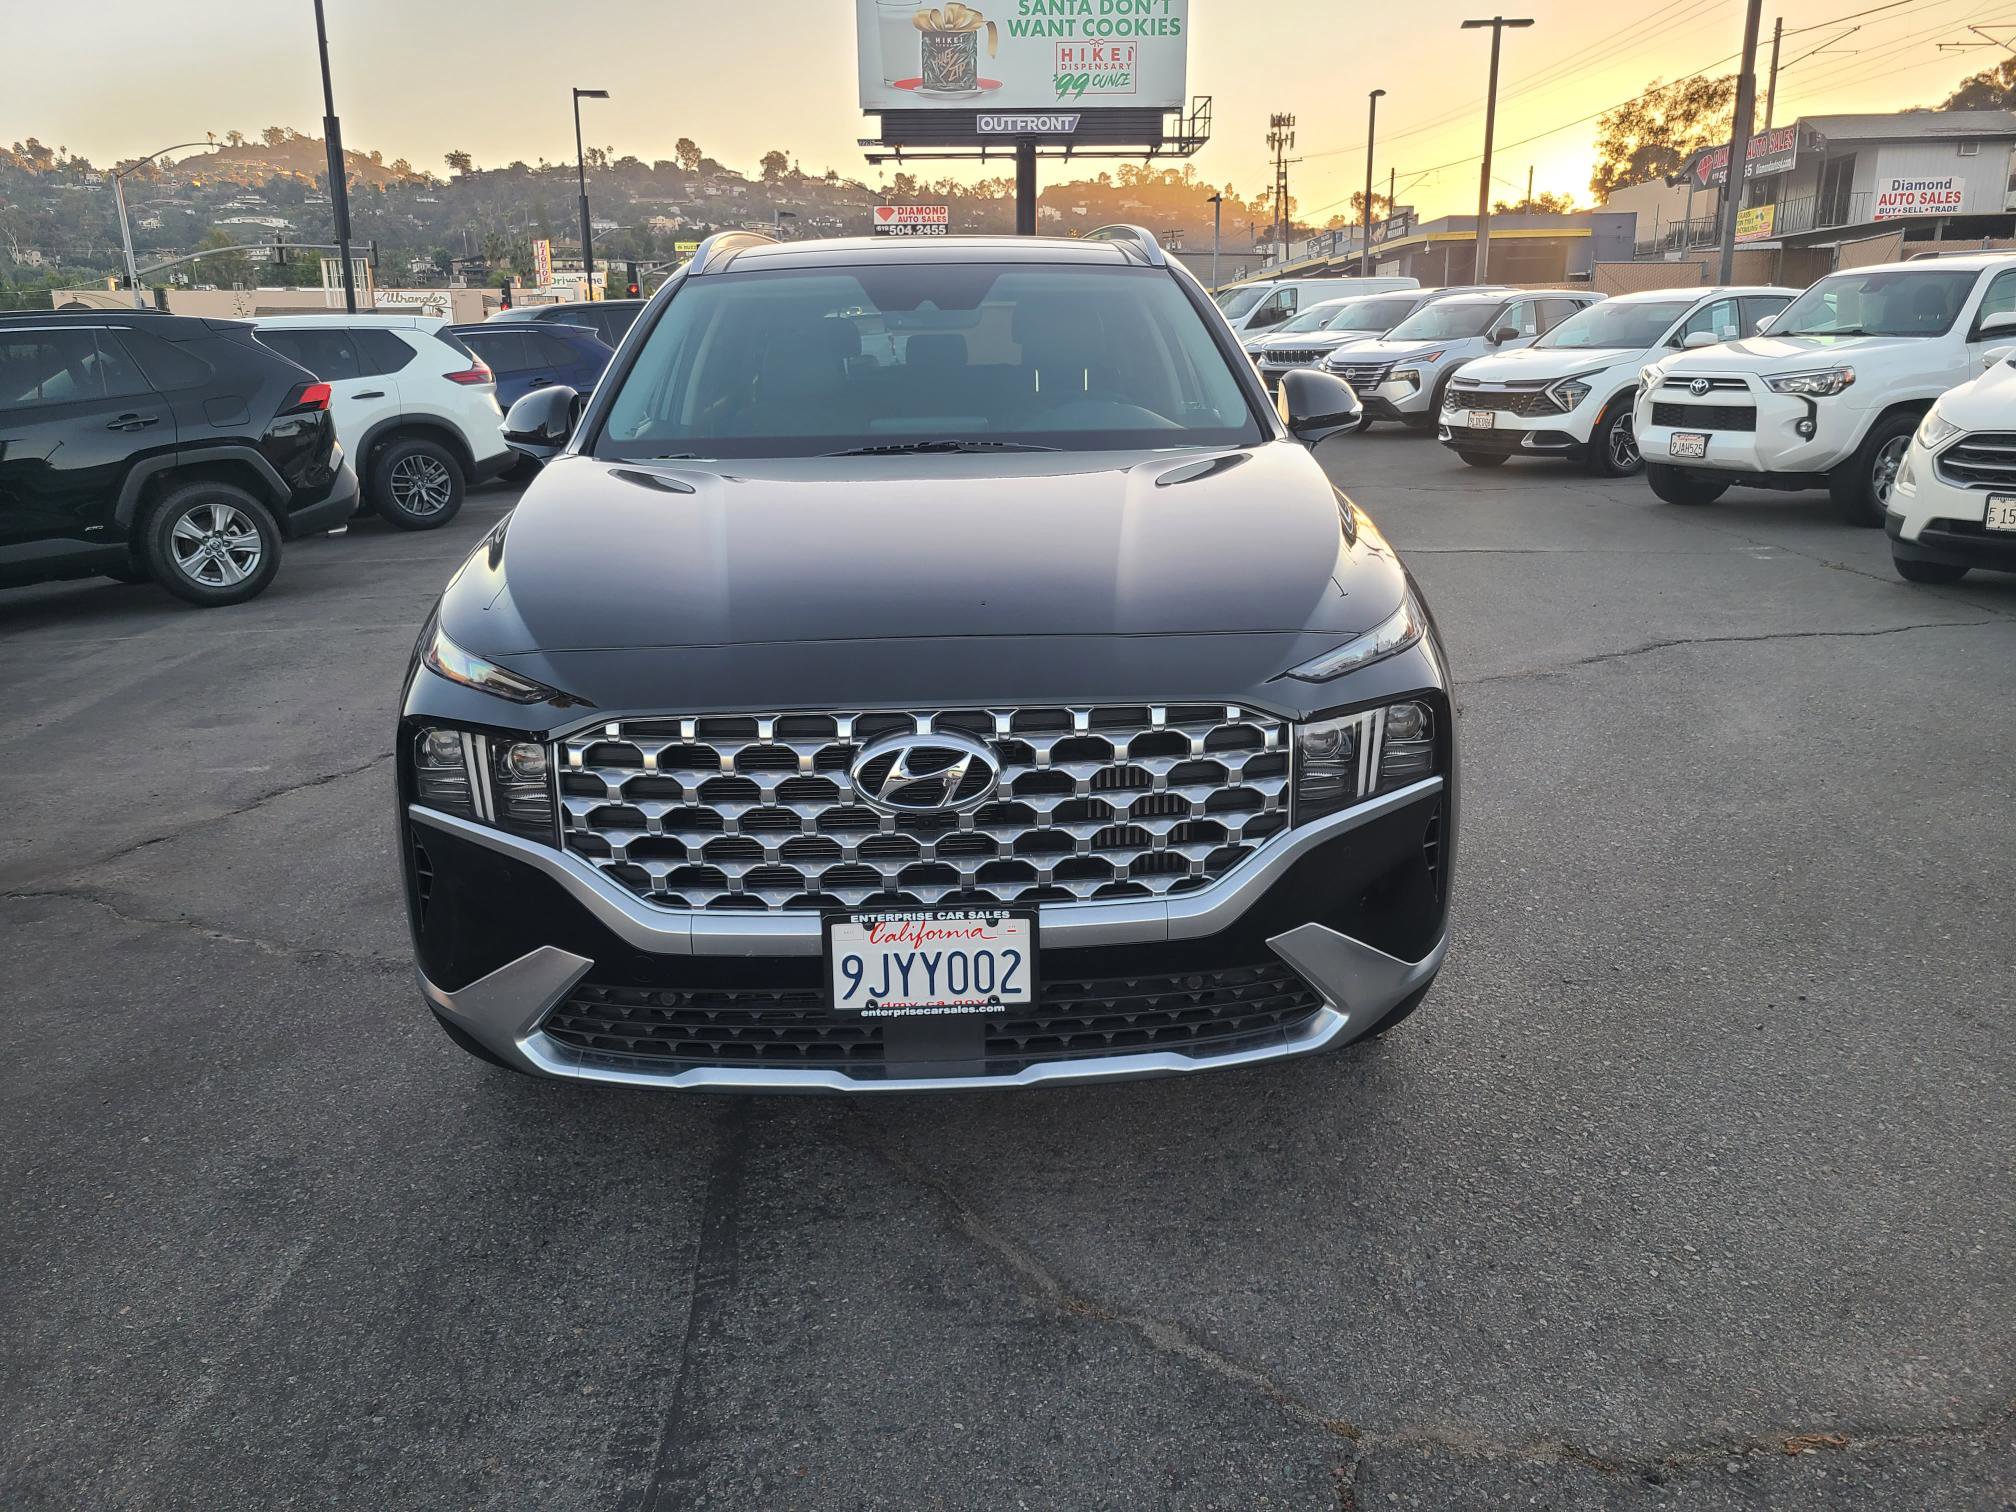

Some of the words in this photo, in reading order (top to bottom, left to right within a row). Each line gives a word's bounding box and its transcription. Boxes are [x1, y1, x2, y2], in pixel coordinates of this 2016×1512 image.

[1018, 0, 1093, 16] SANTA
[1099, 0, 1171, 16] DON'T
[1007, 19, 1077, 37] WANT
[1082, 18, 1181, 37] COOKIES
[1061, 62, 1132, 70] DISPENSARY
[1092, 73, 1130, 88] OUNCE
[981, 117, 1073, 131] OUTFRONT
[1769, 128, 1795, 155] SALES
[1892, 178, 1952, 191] Diamond
[1879, 192, 1915, 206] AUTO
[1919, 191, 1961, 204] SALES
[897, 207, 946, 215] DIAMOND
[1929, 205, 1958, 213] TRADE
[889, 225, 947, 235] 504.2455
[540, 242, 549, 283] LIQUOR
[376, 292, 447, 306] Wrangler
[850, 912, 933, 923] ENTERPRISE
[937, 911, 965, 921] CAR
[968, 910, 1010, 920] SALES
[869, 920, 998, 950] California
[841, 949, 1022, 1000] 9JYY002
[861, 1004, 1005, 1017] enterprisecarsales.com
